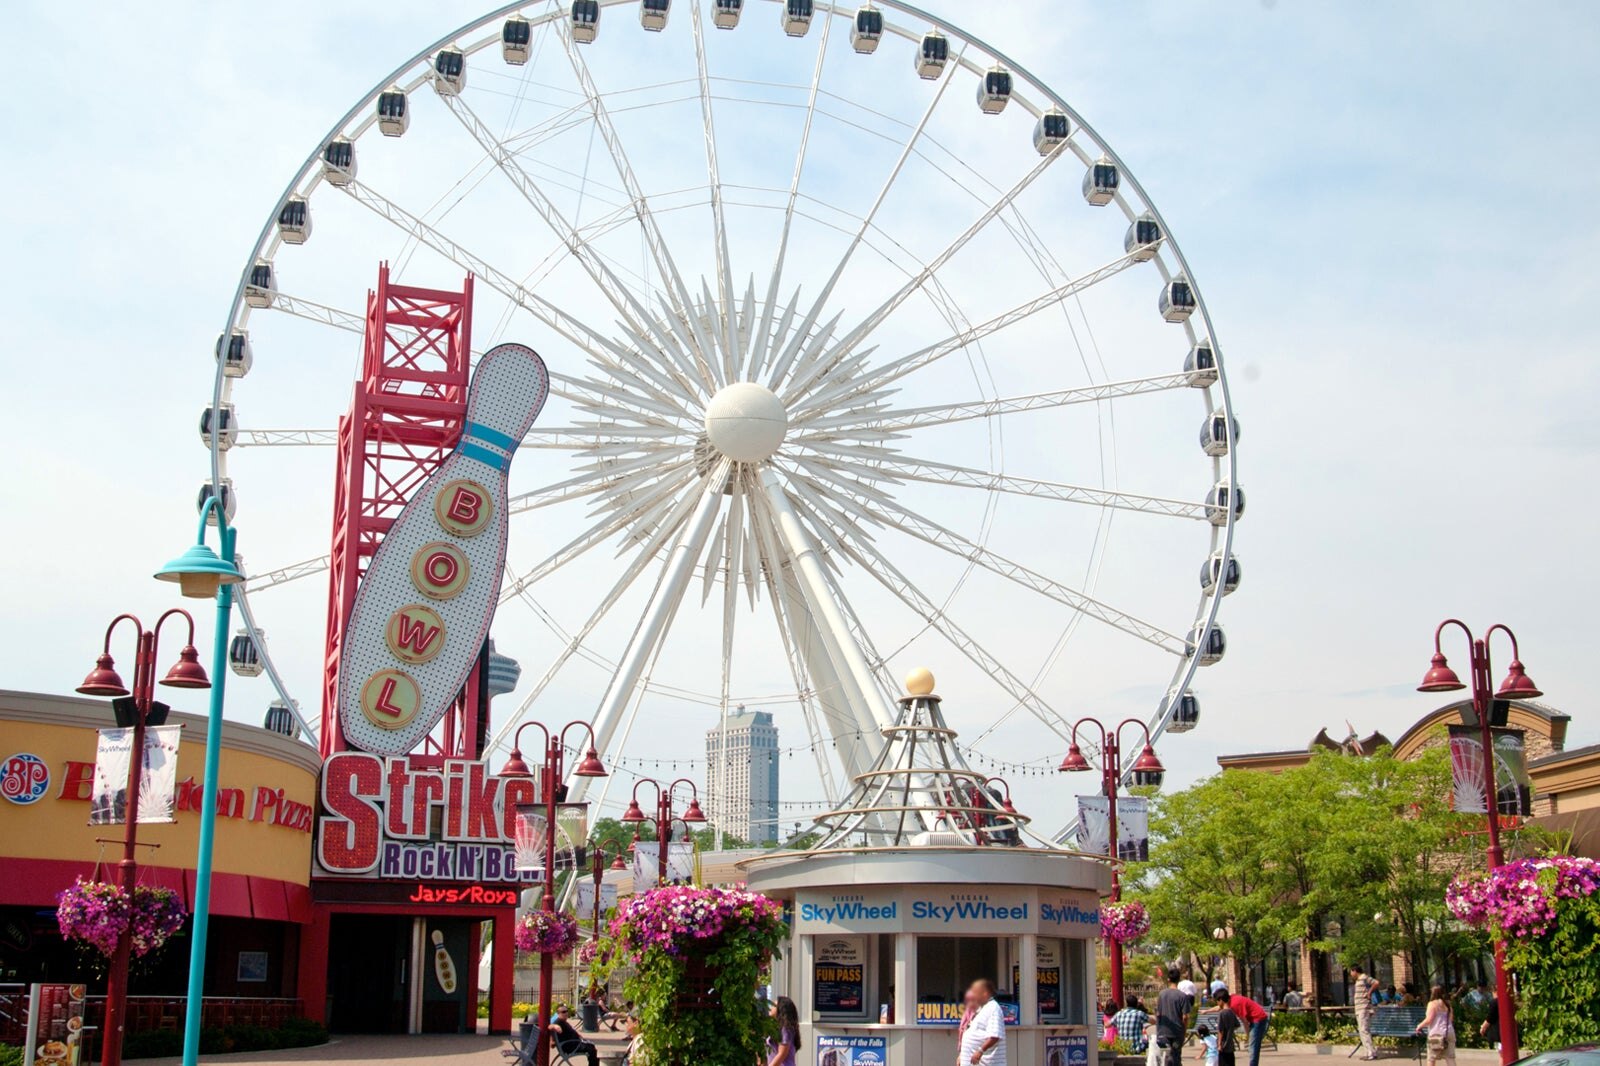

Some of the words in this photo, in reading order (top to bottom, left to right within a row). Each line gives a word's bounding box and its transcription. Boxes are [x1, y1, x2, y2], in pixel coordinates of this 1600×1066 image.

[375, 484, 485, 719] BOWL
[56, 761, 245, 819] Bton
[249, 785, 313, 833] Pizza
[801, 902, 896, 923] SkyWheel
[912, 902, 1028, 922] SkyWheel
[1041, 904, 1099, 924] SkyWheel
[822, 948, 856, 956] SkyWheel
[816, 968, 835, 981] FUN
[837, 968, 861, 982] PASS
[917, 1004, 940, 1019] FUN
[944, 1004, 966, 1019] PAS
[819, 1037, 833, 1046] Best
[835, 1038, 849, 1046] View
[869, 1039, 883, 1047] Falls
